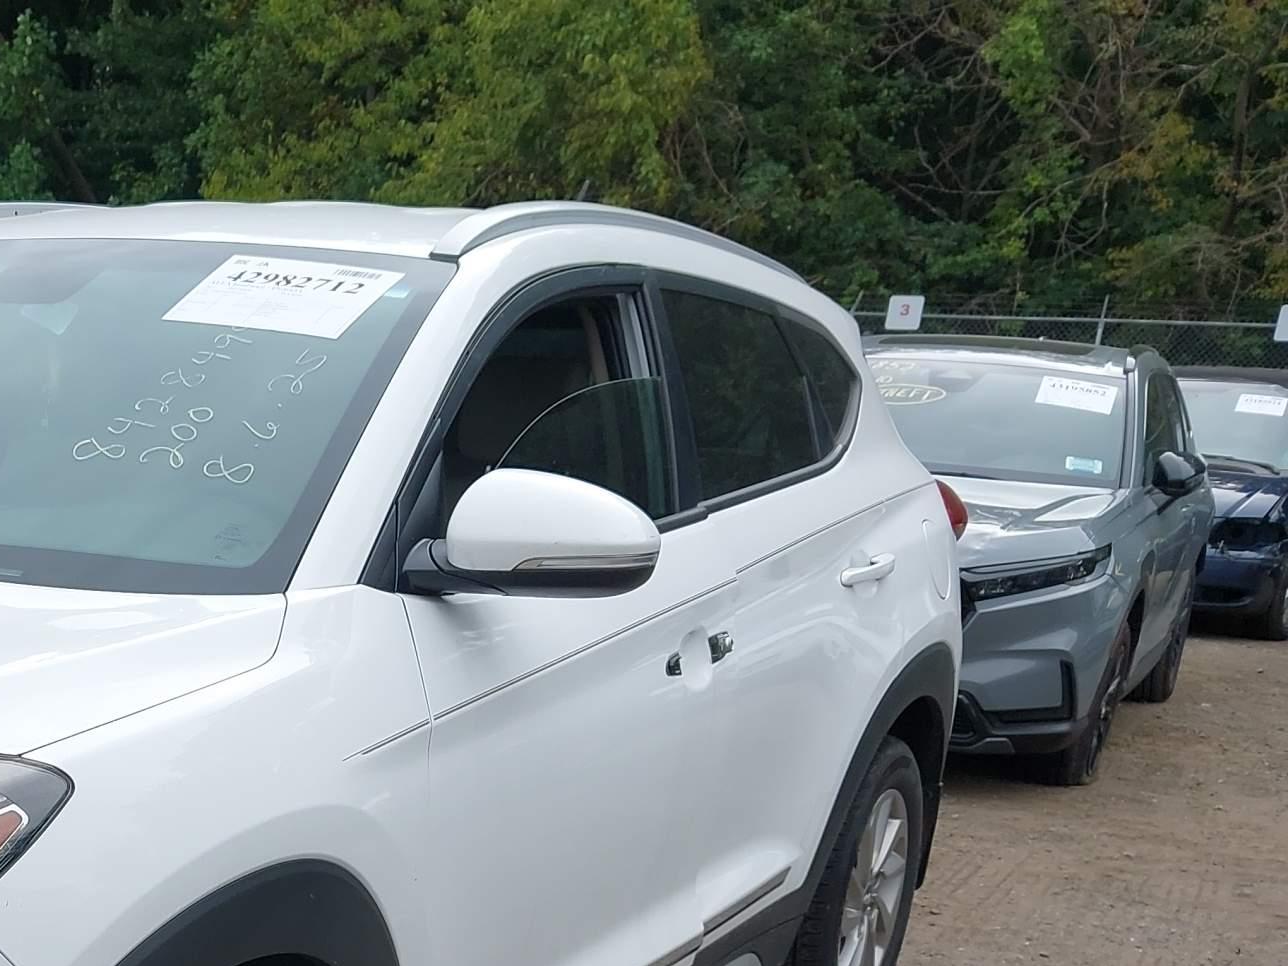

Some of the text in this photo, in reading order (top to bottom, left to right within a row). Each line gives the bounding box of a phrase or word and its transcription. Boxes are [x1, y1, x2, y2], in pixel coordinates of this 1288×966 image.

[226, 269, 365, 295] 42982712
[899, 303, 911, 317] 3
[73, 326, 253, 460] 842849
[140, 406, 213, 468] 200
